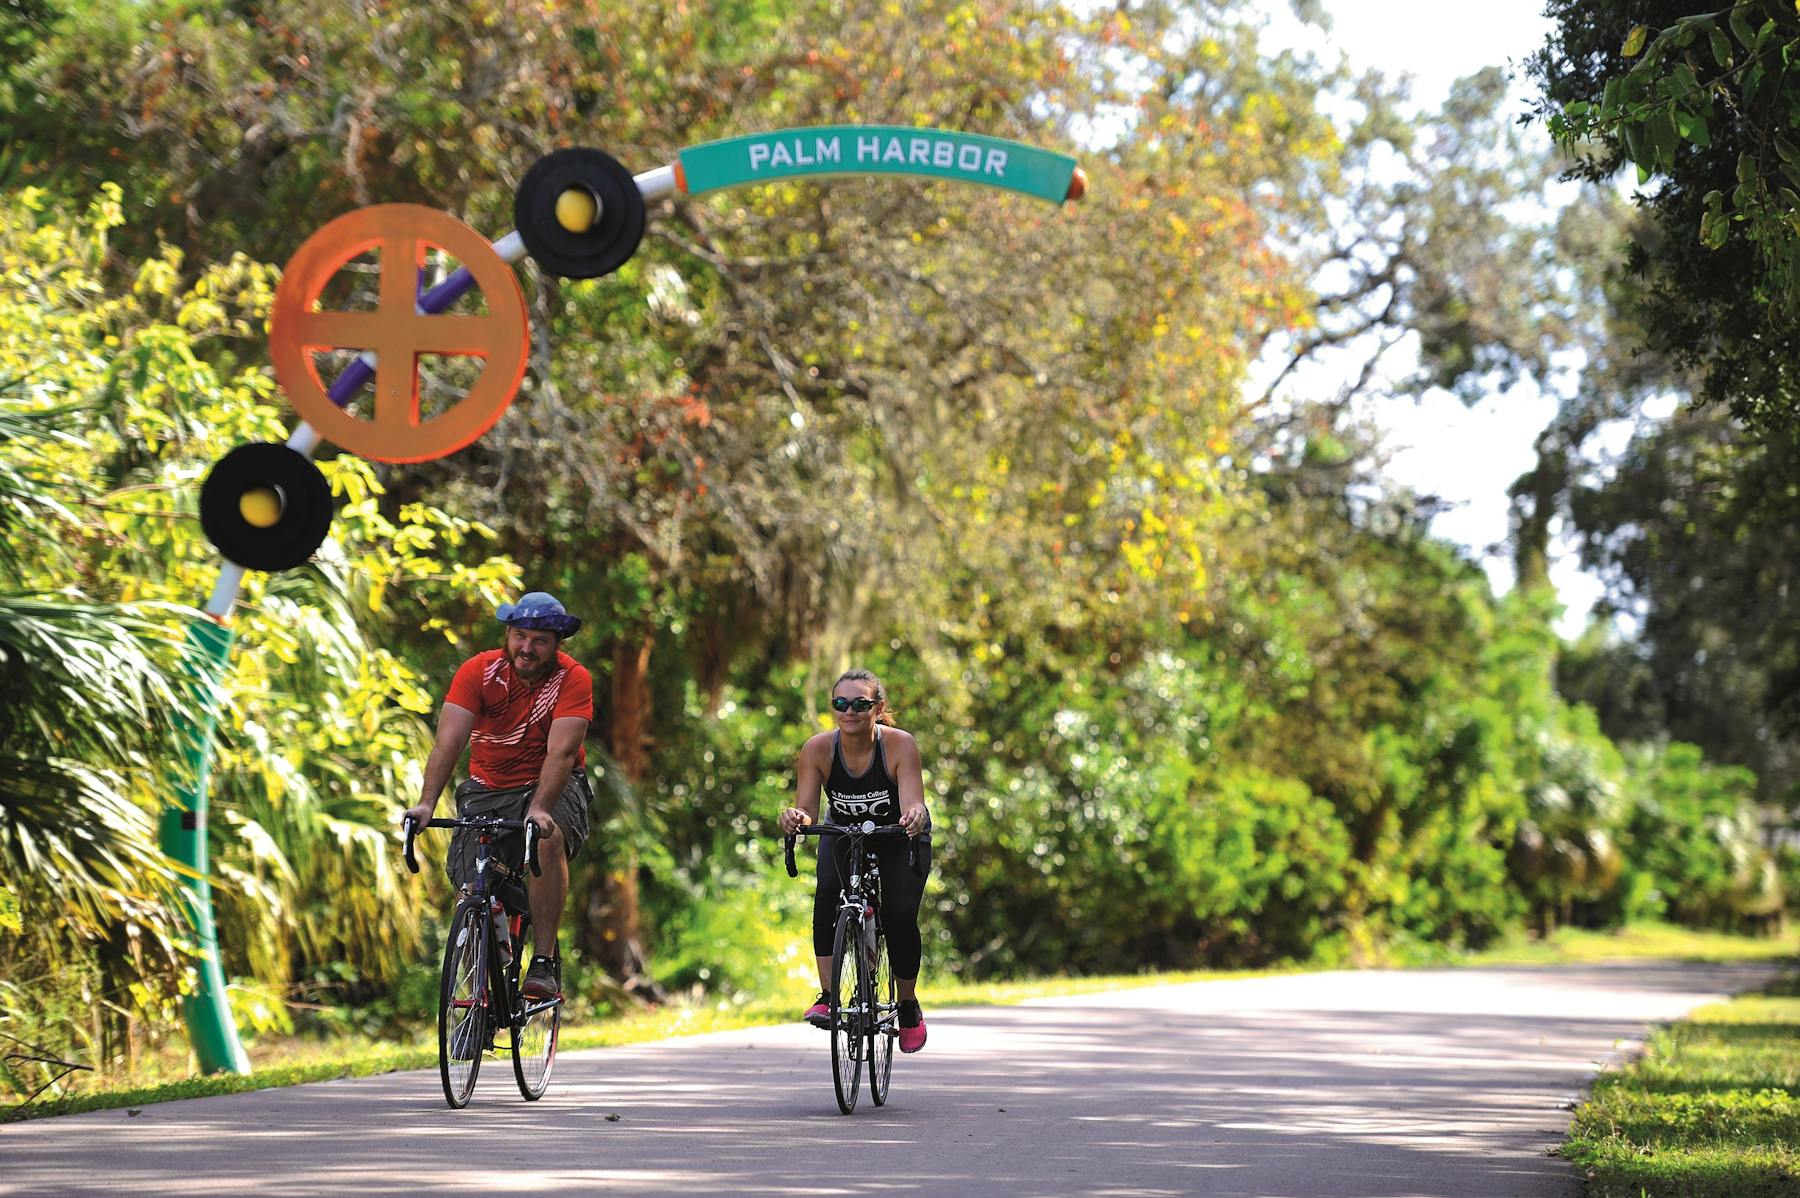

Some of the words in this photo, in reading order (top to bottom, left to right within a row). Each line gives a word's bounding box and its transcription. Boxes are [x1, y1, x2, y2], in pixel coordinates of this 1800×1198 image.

[748, 136, 841, 171] PALM
[856, 136, 1009, 176] HARBOR
[838, 792, 867, 800] Petersburg
[867, 790, 888, 799] College
[833, 798, 890, 817] SPC
